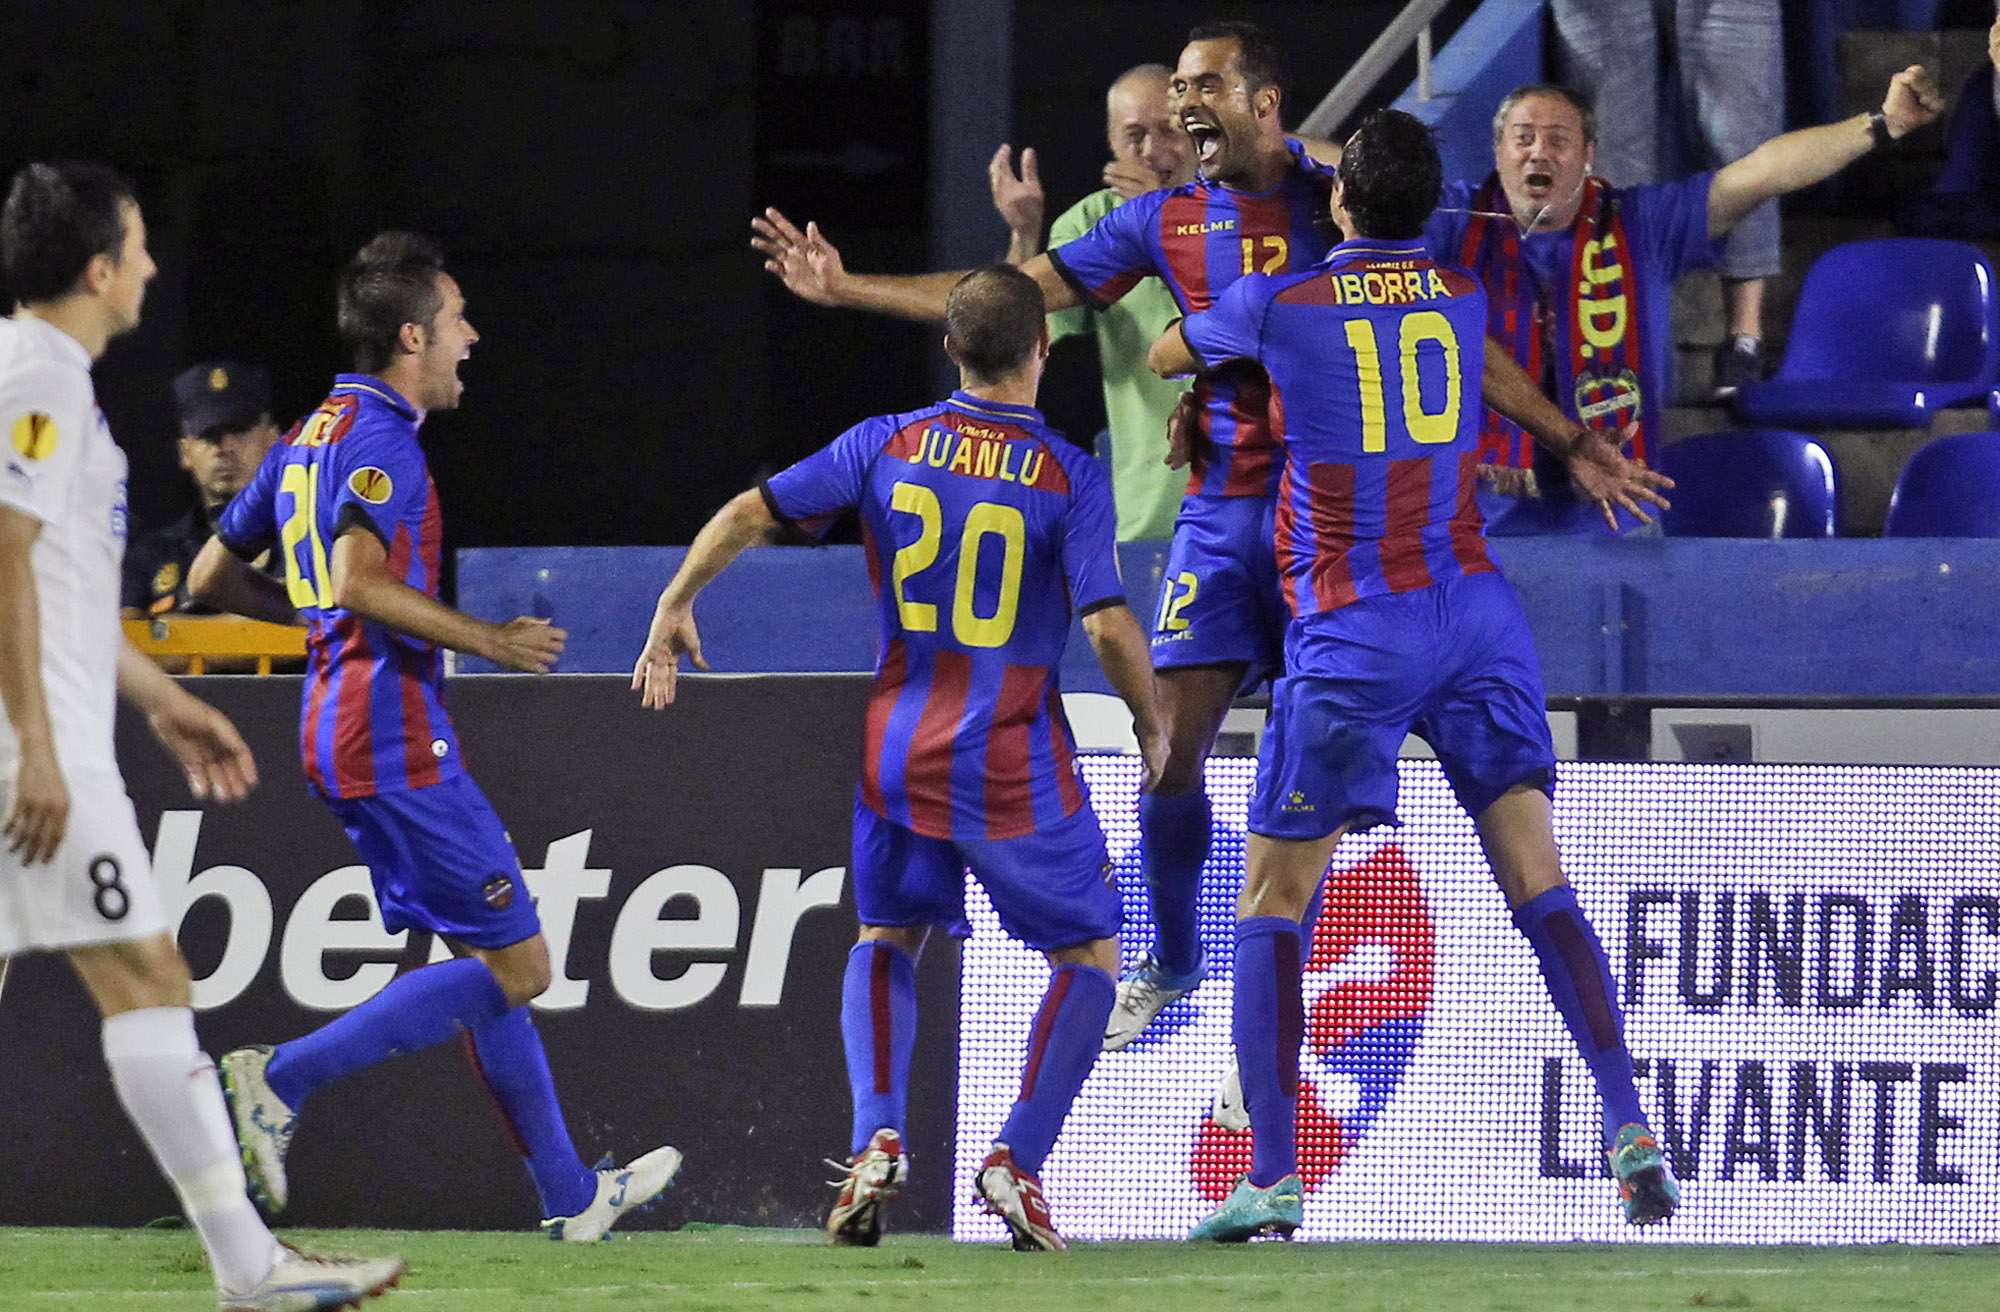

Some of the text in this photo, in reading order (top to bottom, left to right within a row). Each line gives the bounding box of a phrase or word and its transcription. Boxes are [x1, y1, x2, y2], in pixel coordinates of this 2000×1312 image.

[1177, 220, 1235, 236] KELME
[1331, 268, 1453, 305] IBORRA
[1343, 310, 1463, 453] 10
[908, 428, 1046, 487] JUANLU
[279, 462, 335, 610] 21
[890, 480, 1027, 649] 20
[1157, 571, 1199, 632] 12
[89, 856, 129, 921] 8
[150, 809, 847, 1011] beter
[1540, 1058, 1970, 1185] LVANTE
